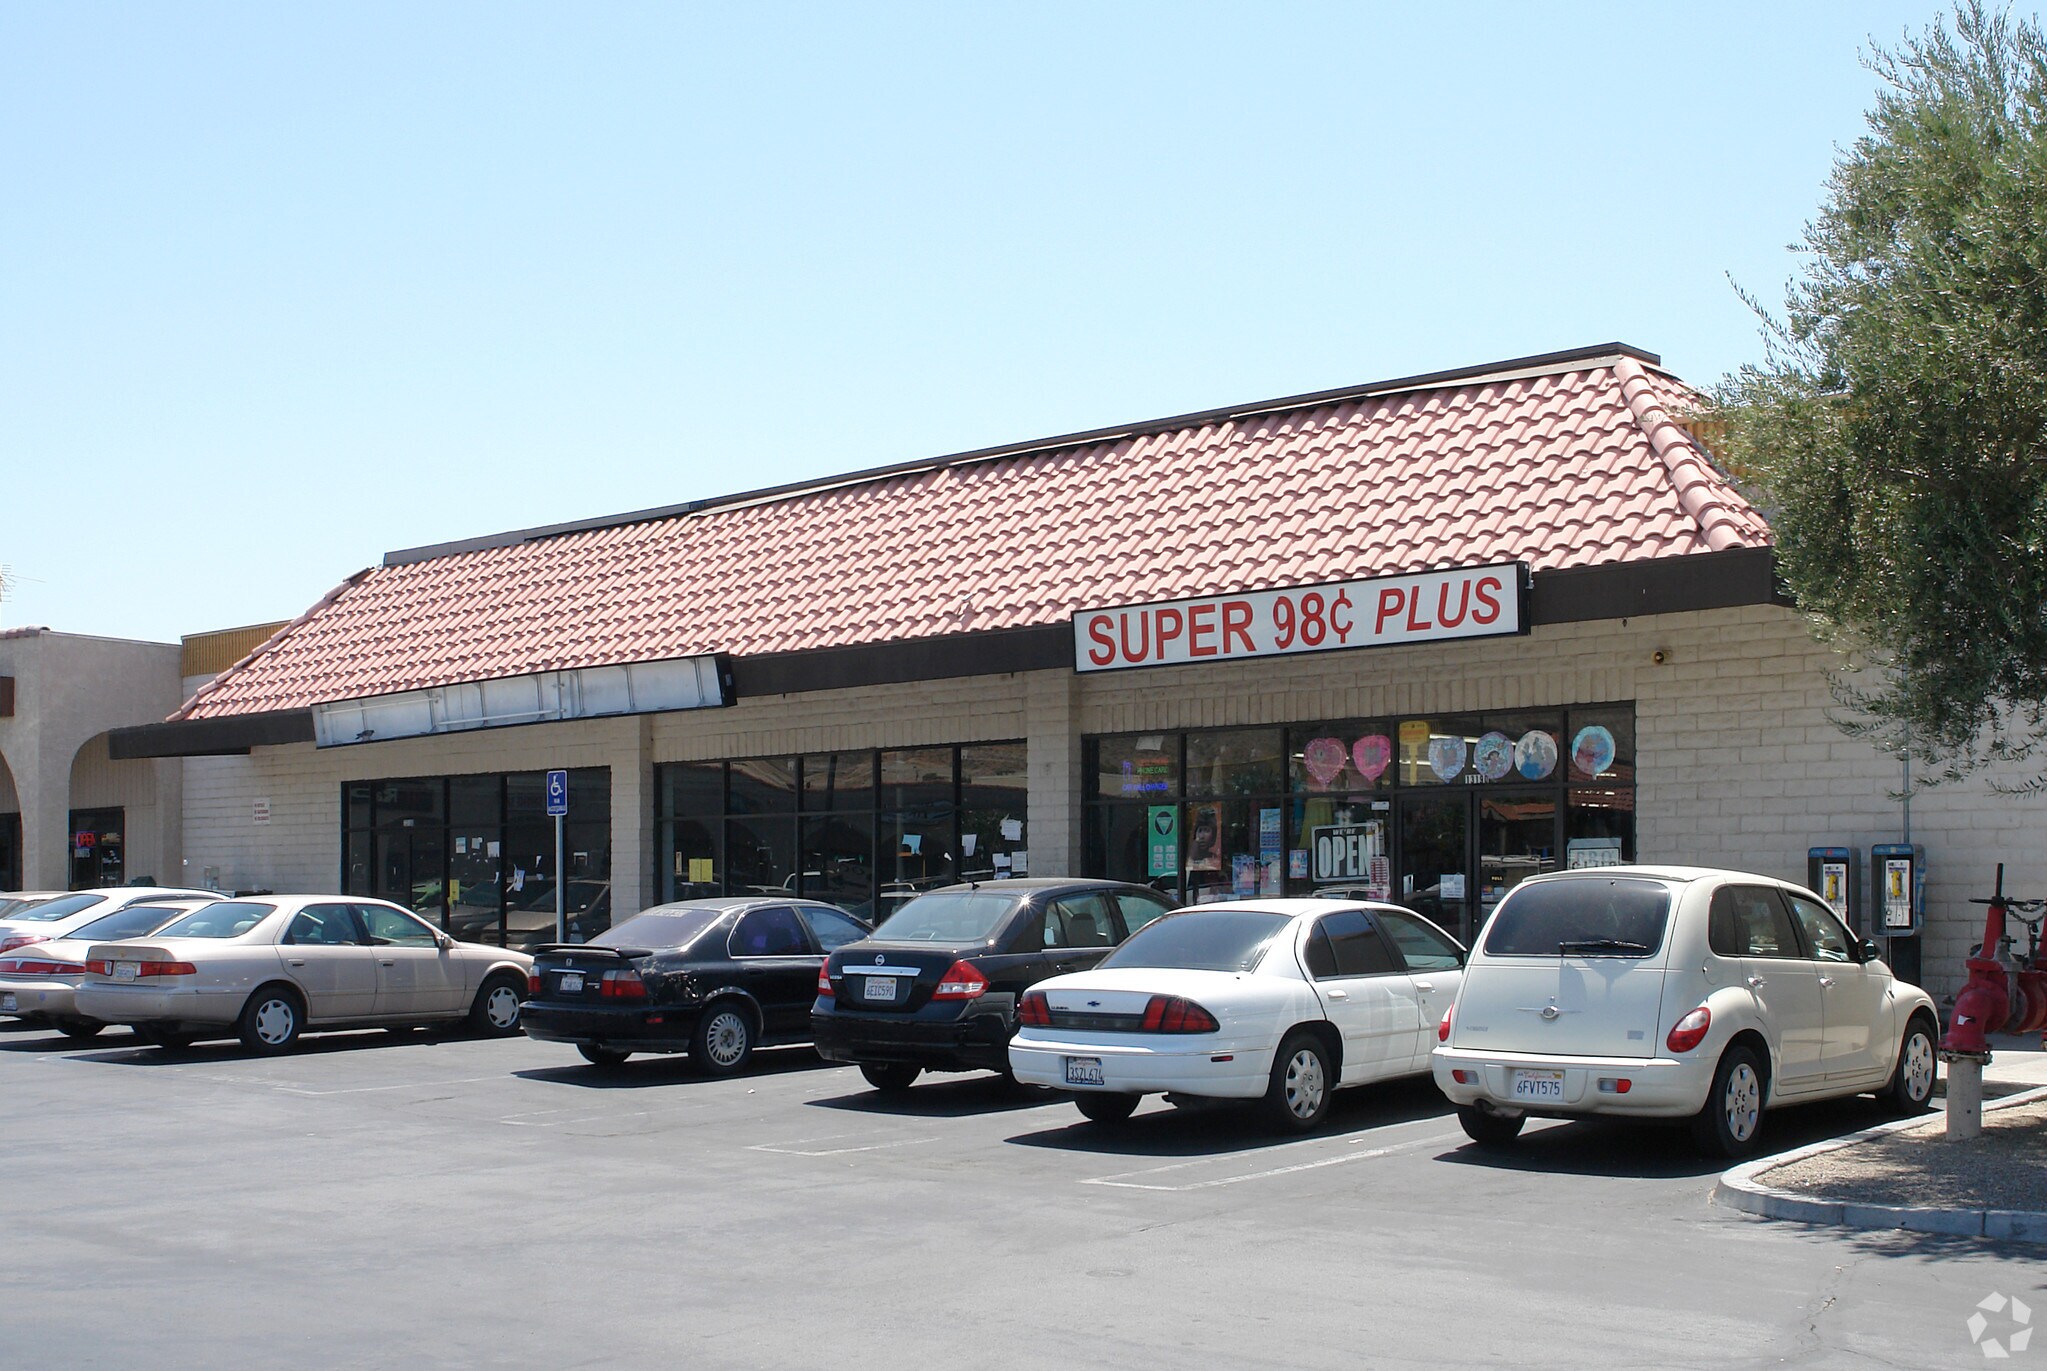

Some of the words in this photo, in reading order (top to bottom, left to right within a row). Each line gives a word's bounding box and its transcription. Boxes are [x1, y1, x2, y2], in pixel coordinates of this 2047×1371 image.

[1088, 600, 1257, 666] SUPER
[1272, 587, 1354, 650] 98¢
[1374, 576, 1503, 635] PLUS
[1332, 828, 1357, 836] WE'RE
[1318, 834, 1373, 878] OPEN
[866, 985, 894, 997] 6EIC590
[1516, 1080, 1560, 1096] 6FVT575
